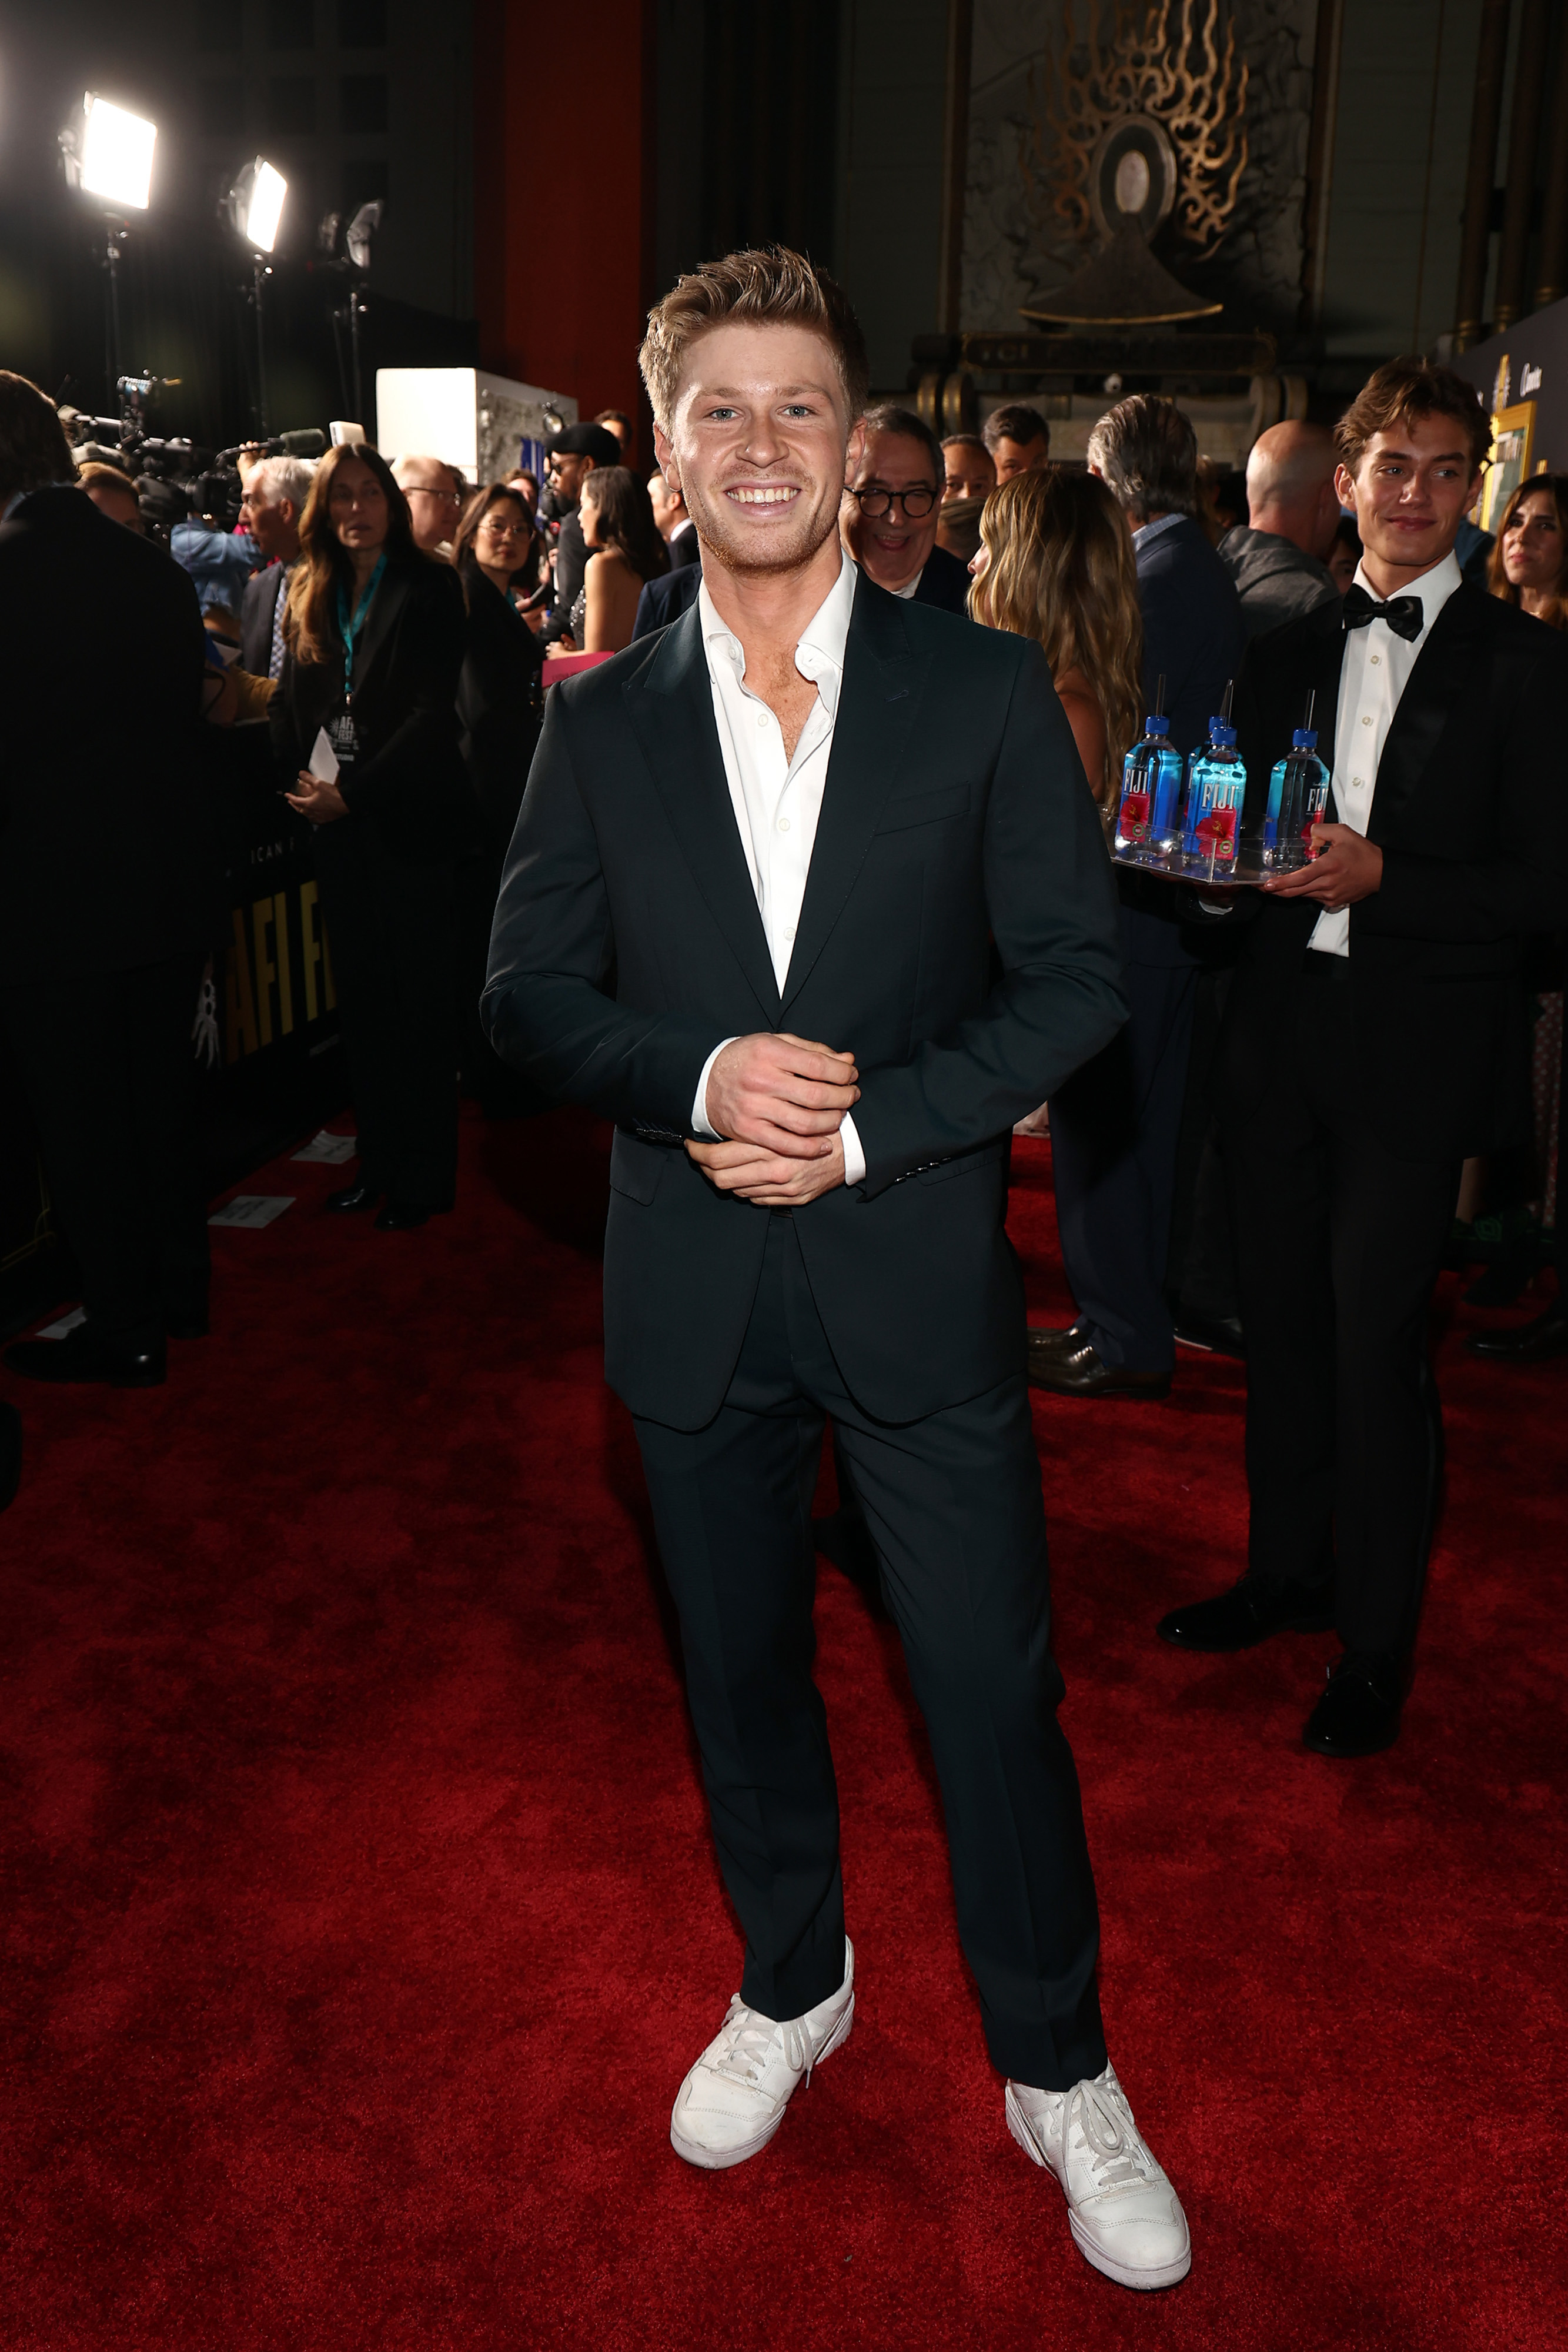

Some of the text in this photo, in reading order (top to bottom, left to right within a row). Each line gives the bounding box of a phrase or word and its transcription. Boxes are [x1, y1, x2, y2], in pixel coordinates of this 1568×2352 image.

[1124, 769, 1148, 794] FIJI
[1202, 783, 1235, 810] FIJI
[225, 891, 293, 1065] AFI
